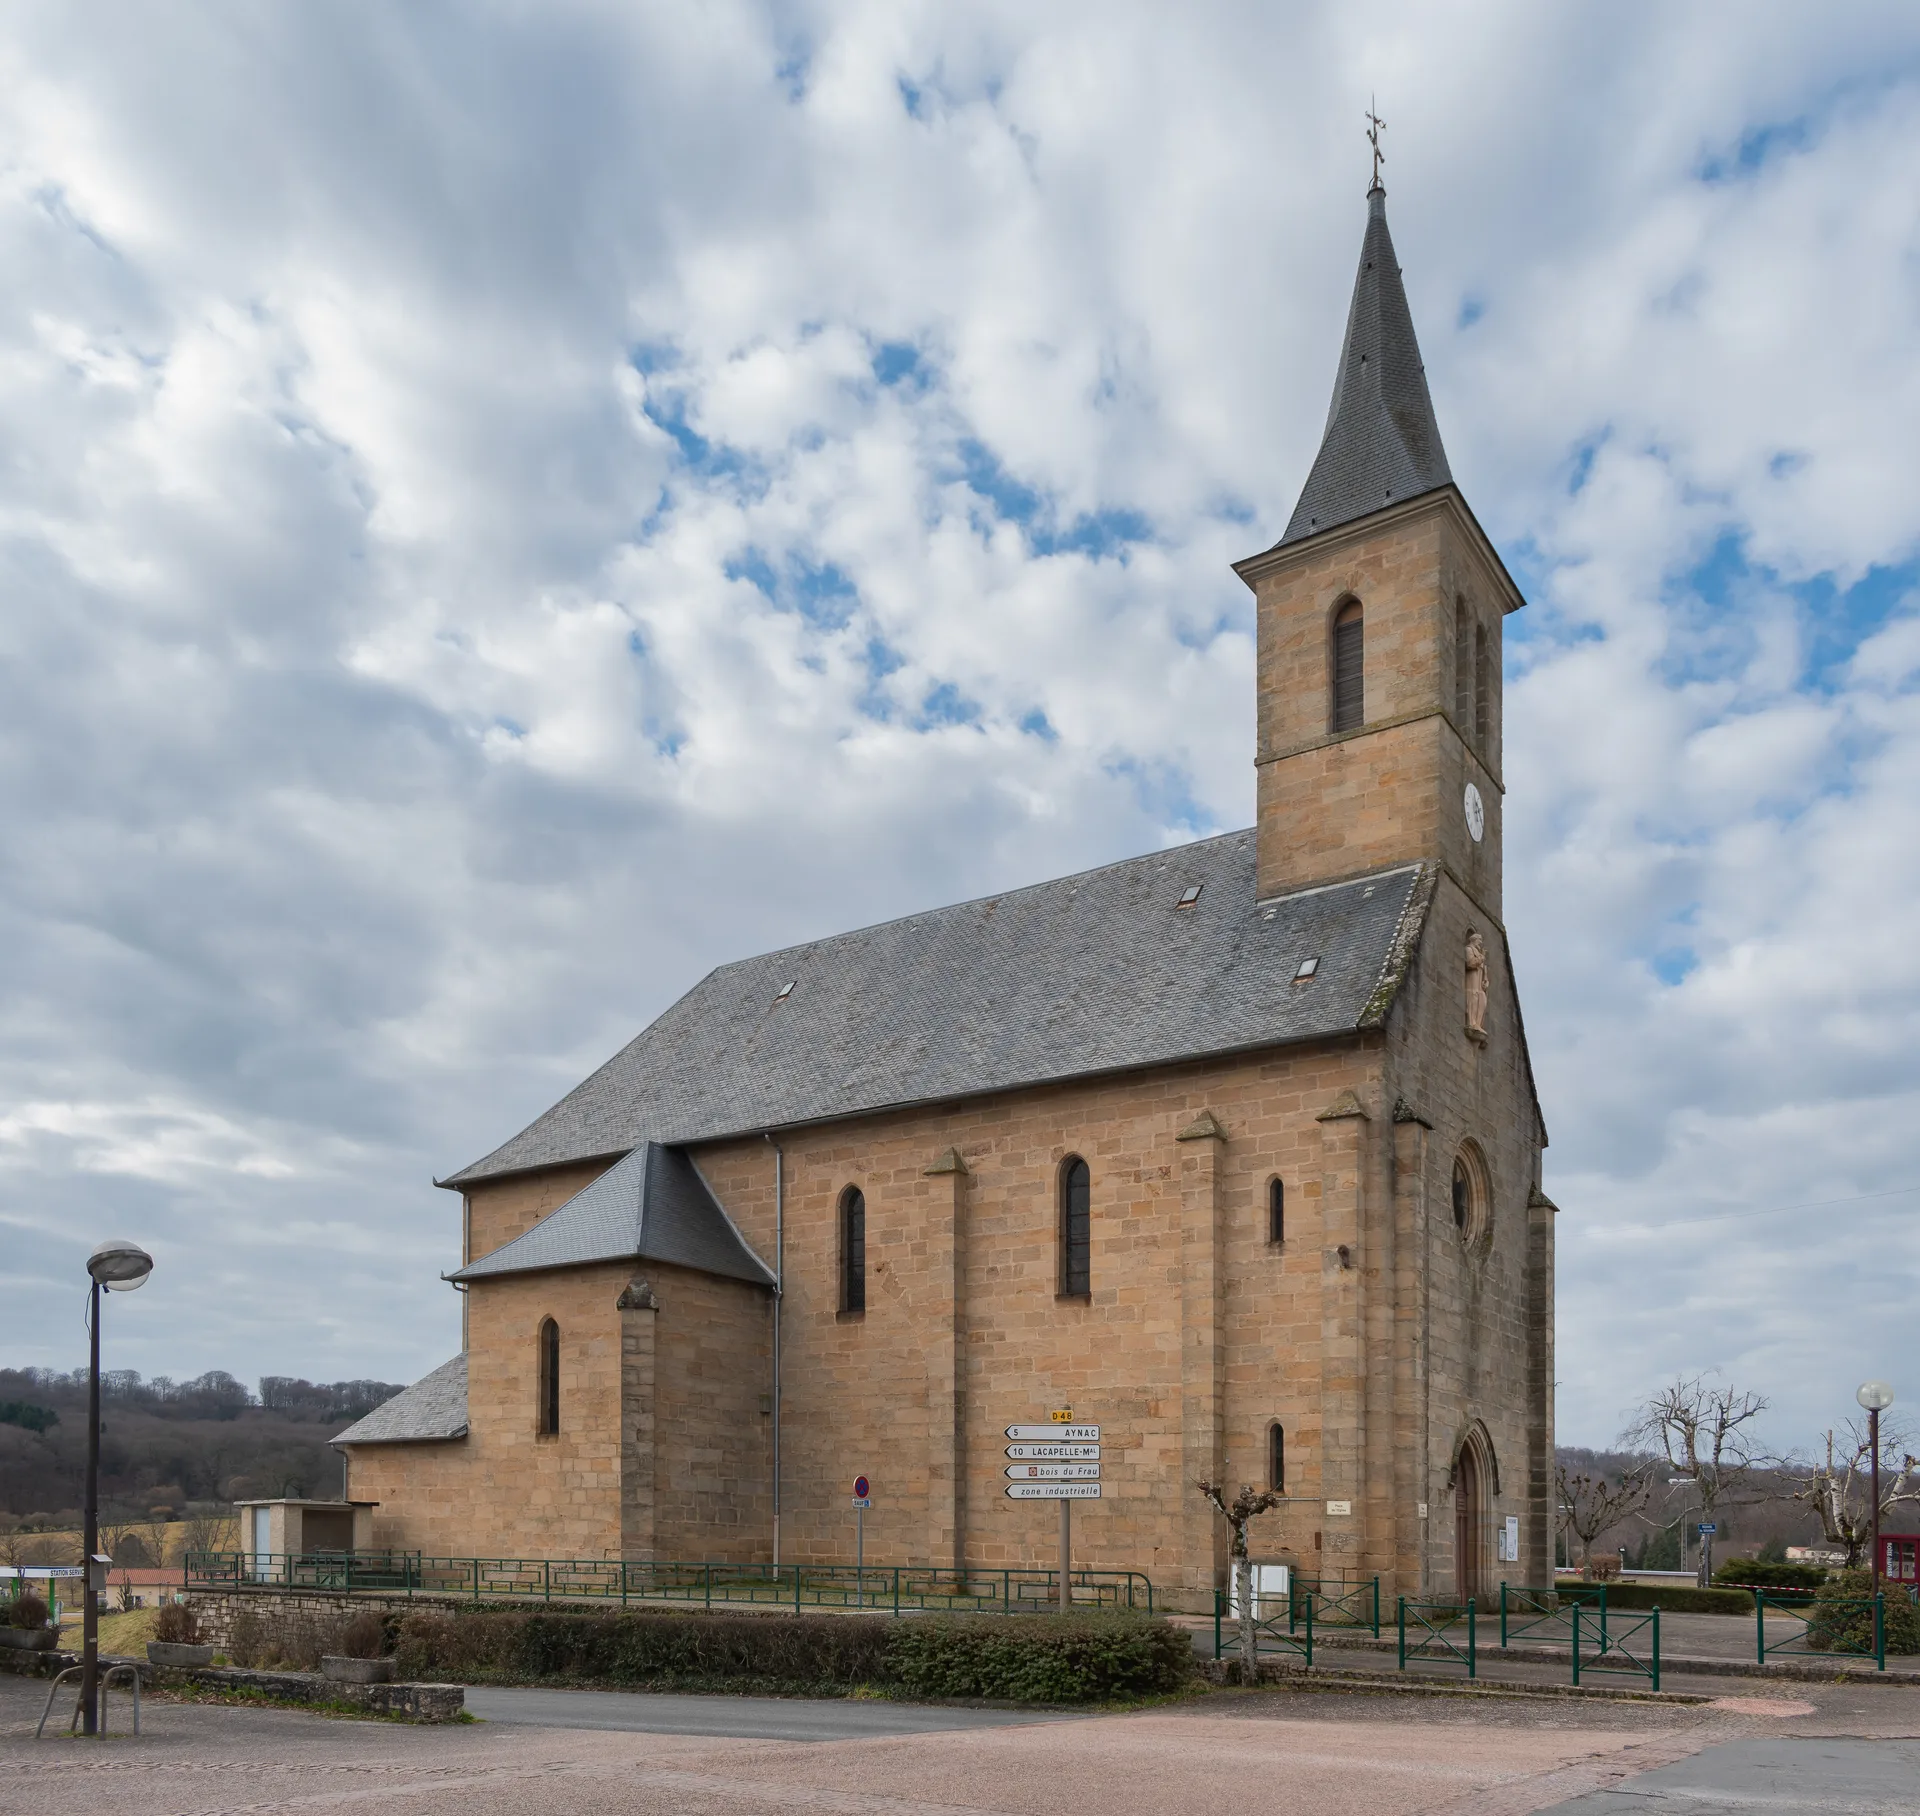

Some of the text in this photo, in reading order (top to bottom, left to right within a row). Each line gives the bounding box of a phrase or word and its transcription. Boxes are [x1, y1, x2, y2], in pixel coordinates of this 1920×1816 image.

[1060, 1412, 1072, 1420] 48
[1065, 1429, 1096, 1437] AYNAC
[1013, 1448, 1024, 1456] 10
[1040, 1468, 1058, 1476] bois
[1078, 1467, 1097, 1475] Frau
[1045, 1487, 1098, 1495] industrielle
[50, 1569, 68, 1577] STATION
